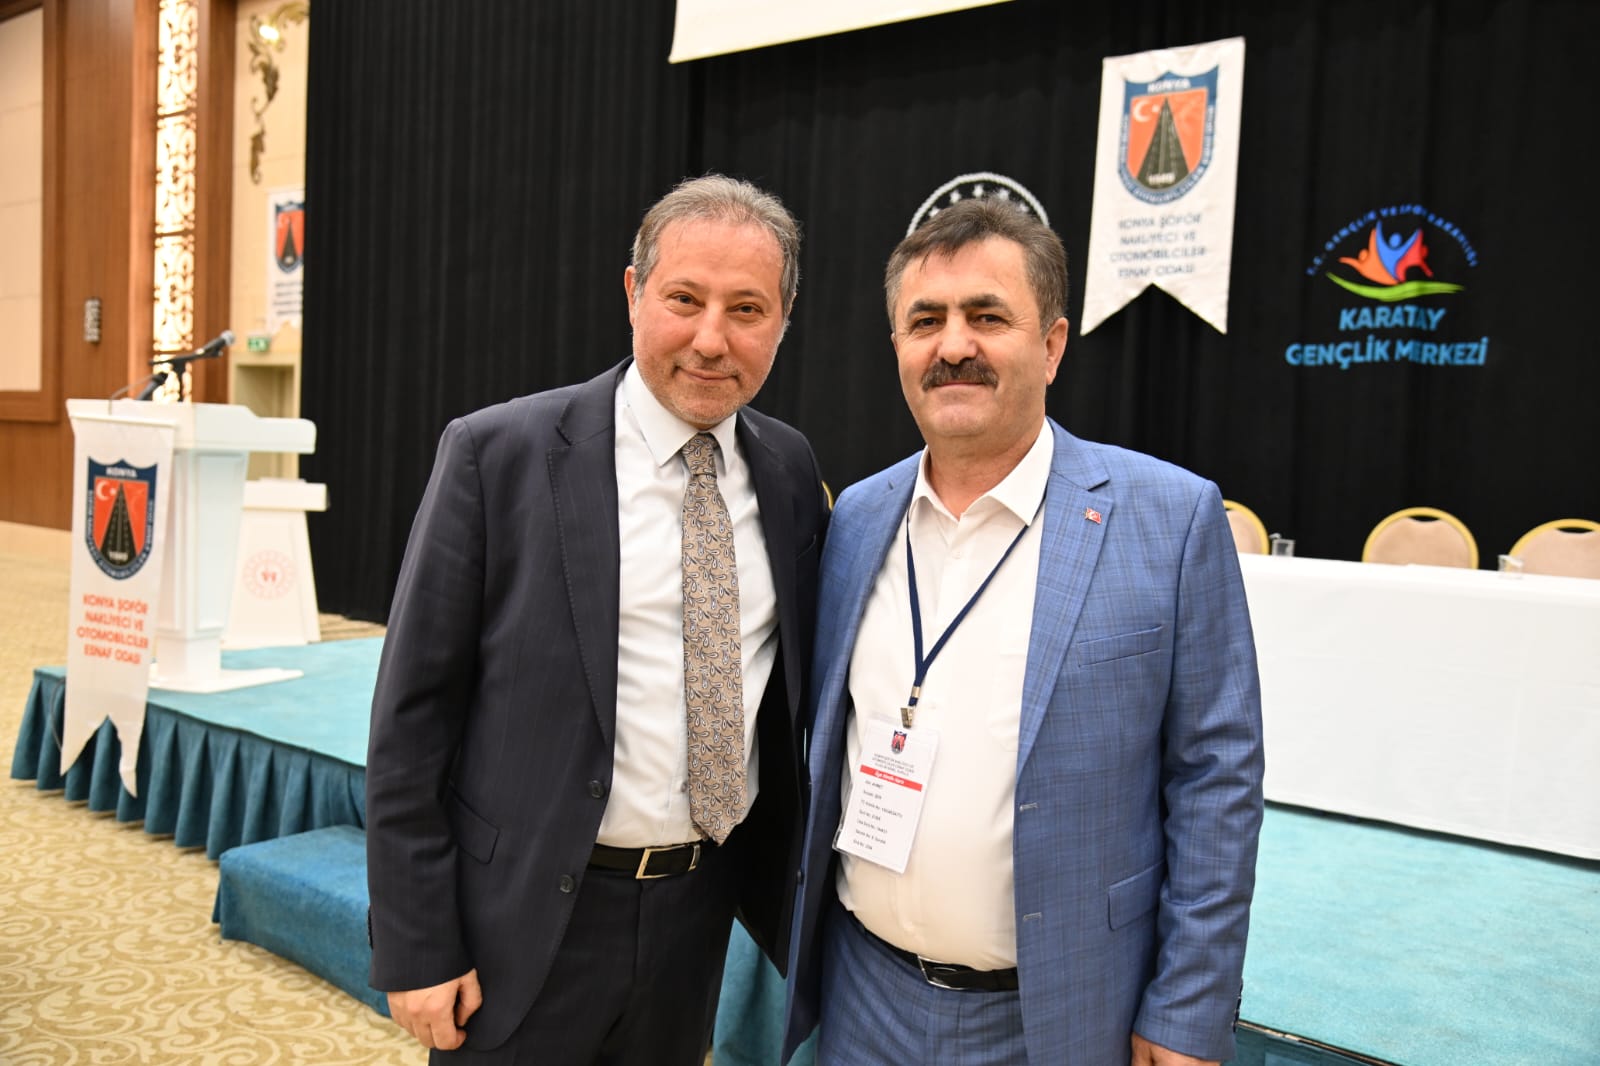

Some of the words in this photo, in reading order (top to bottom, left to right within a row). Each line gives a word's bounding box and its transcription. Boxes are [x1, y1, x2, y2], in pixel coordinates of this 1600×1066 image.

[1338, 304, 1447, 332] KARATAY
[1285, 334, 1391, 370] GENÇLİK
[1394, 336, 1489, 366] MERKEZİ
[83, 594, 114, 608] KONYA
[118, 598, 148, 614] ŞOFÖR
[135, 619, 144, 632] VE
[84, 643, 112, 658] ESNAF
